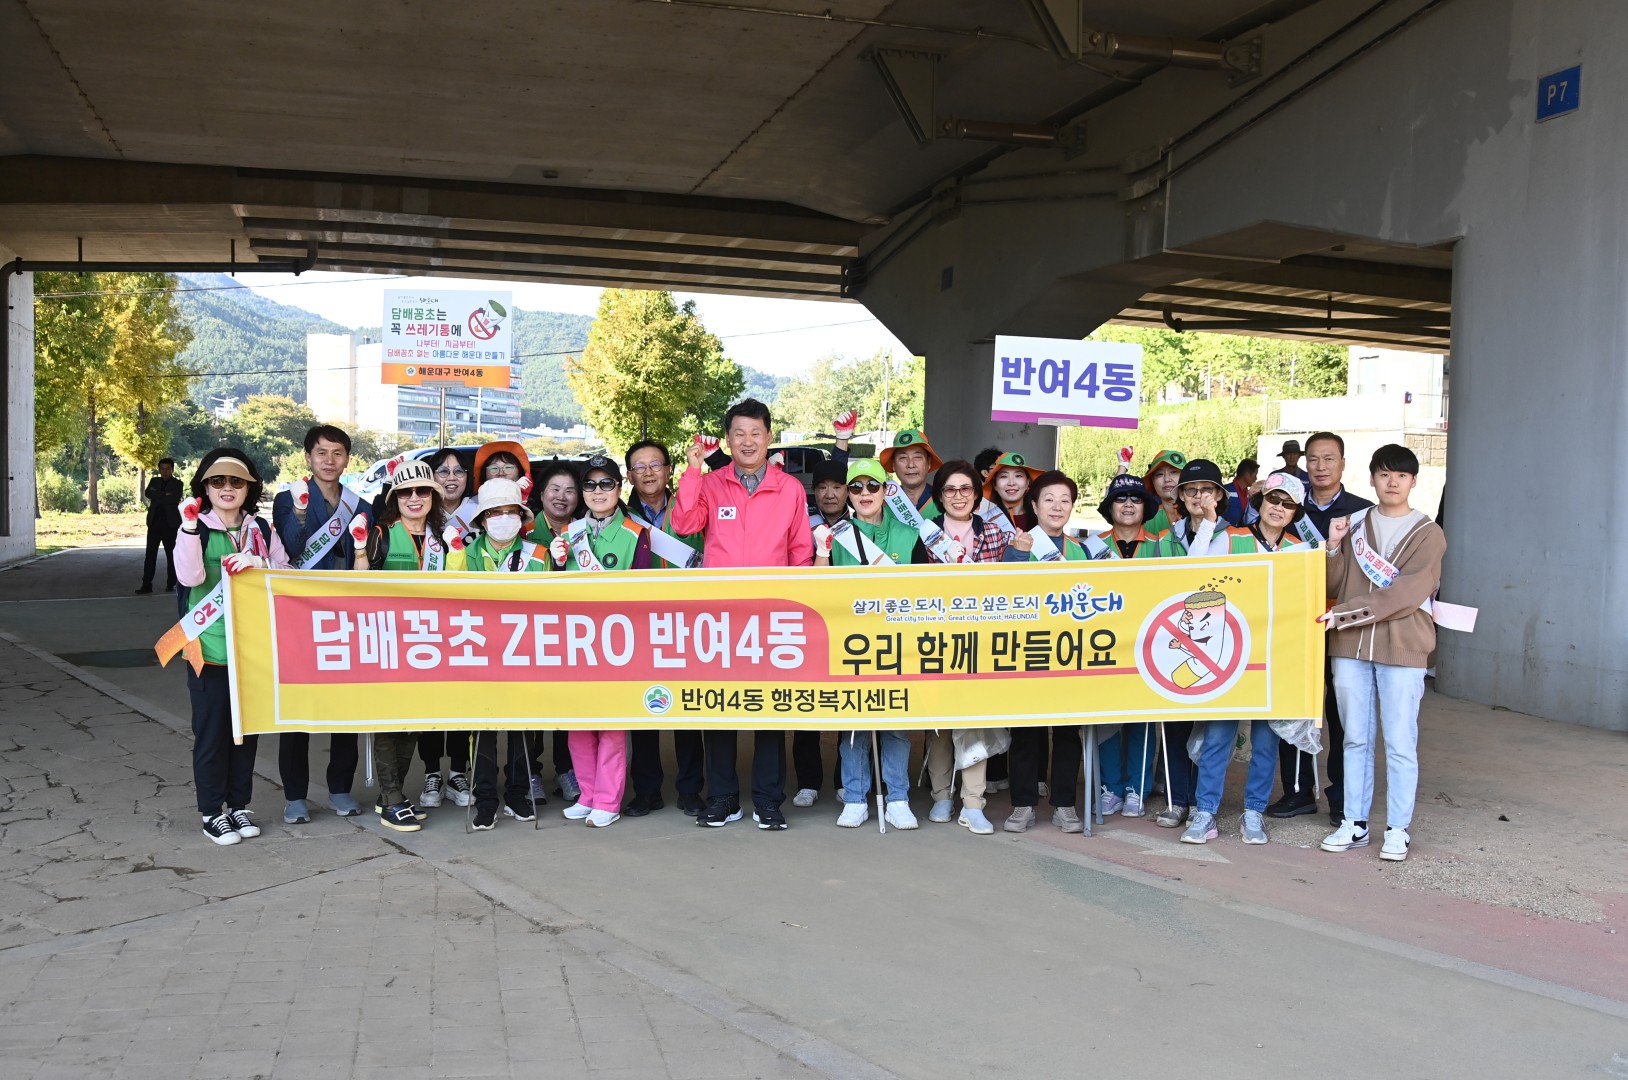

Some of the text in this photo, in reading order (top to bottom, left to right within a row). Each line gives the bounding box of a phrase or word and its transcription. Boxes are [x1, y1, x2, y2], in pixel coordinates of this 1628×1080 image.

[1547, 80, 1568, 106] P7
[391, 307, 447, 321] 담배꽁초는
[390, 322, 462, 337] 꼭 쓰레기통에
[387, 349, 414, 357] 담배꽁초
[432, 350, 459, 359] 아름다운
[461, 350, 482, 359] 해운대
[484, 351, 505, 360] 만들기
[418, 367, 483, 377] 해운대구 반여4동
[1001, 356, 1136, 402] 반여4동
[394, 465, 432, 485] VILLAIN
[853, 592, 1123, 620] 살기 좋은 도시, 오고 싶은 도시 해운대
[904, 615, 917, 623] city
[966, 614, 979, 622] city
[988, 613, 1004, 621] visit,
[311, 609, 807, 671] 담배꽁초 ZERO 반여4동
[842, 629, 1117, 676] 우리 함께 만들어요
[681, 688, 909, 713] 반여4동 행정복지센터
